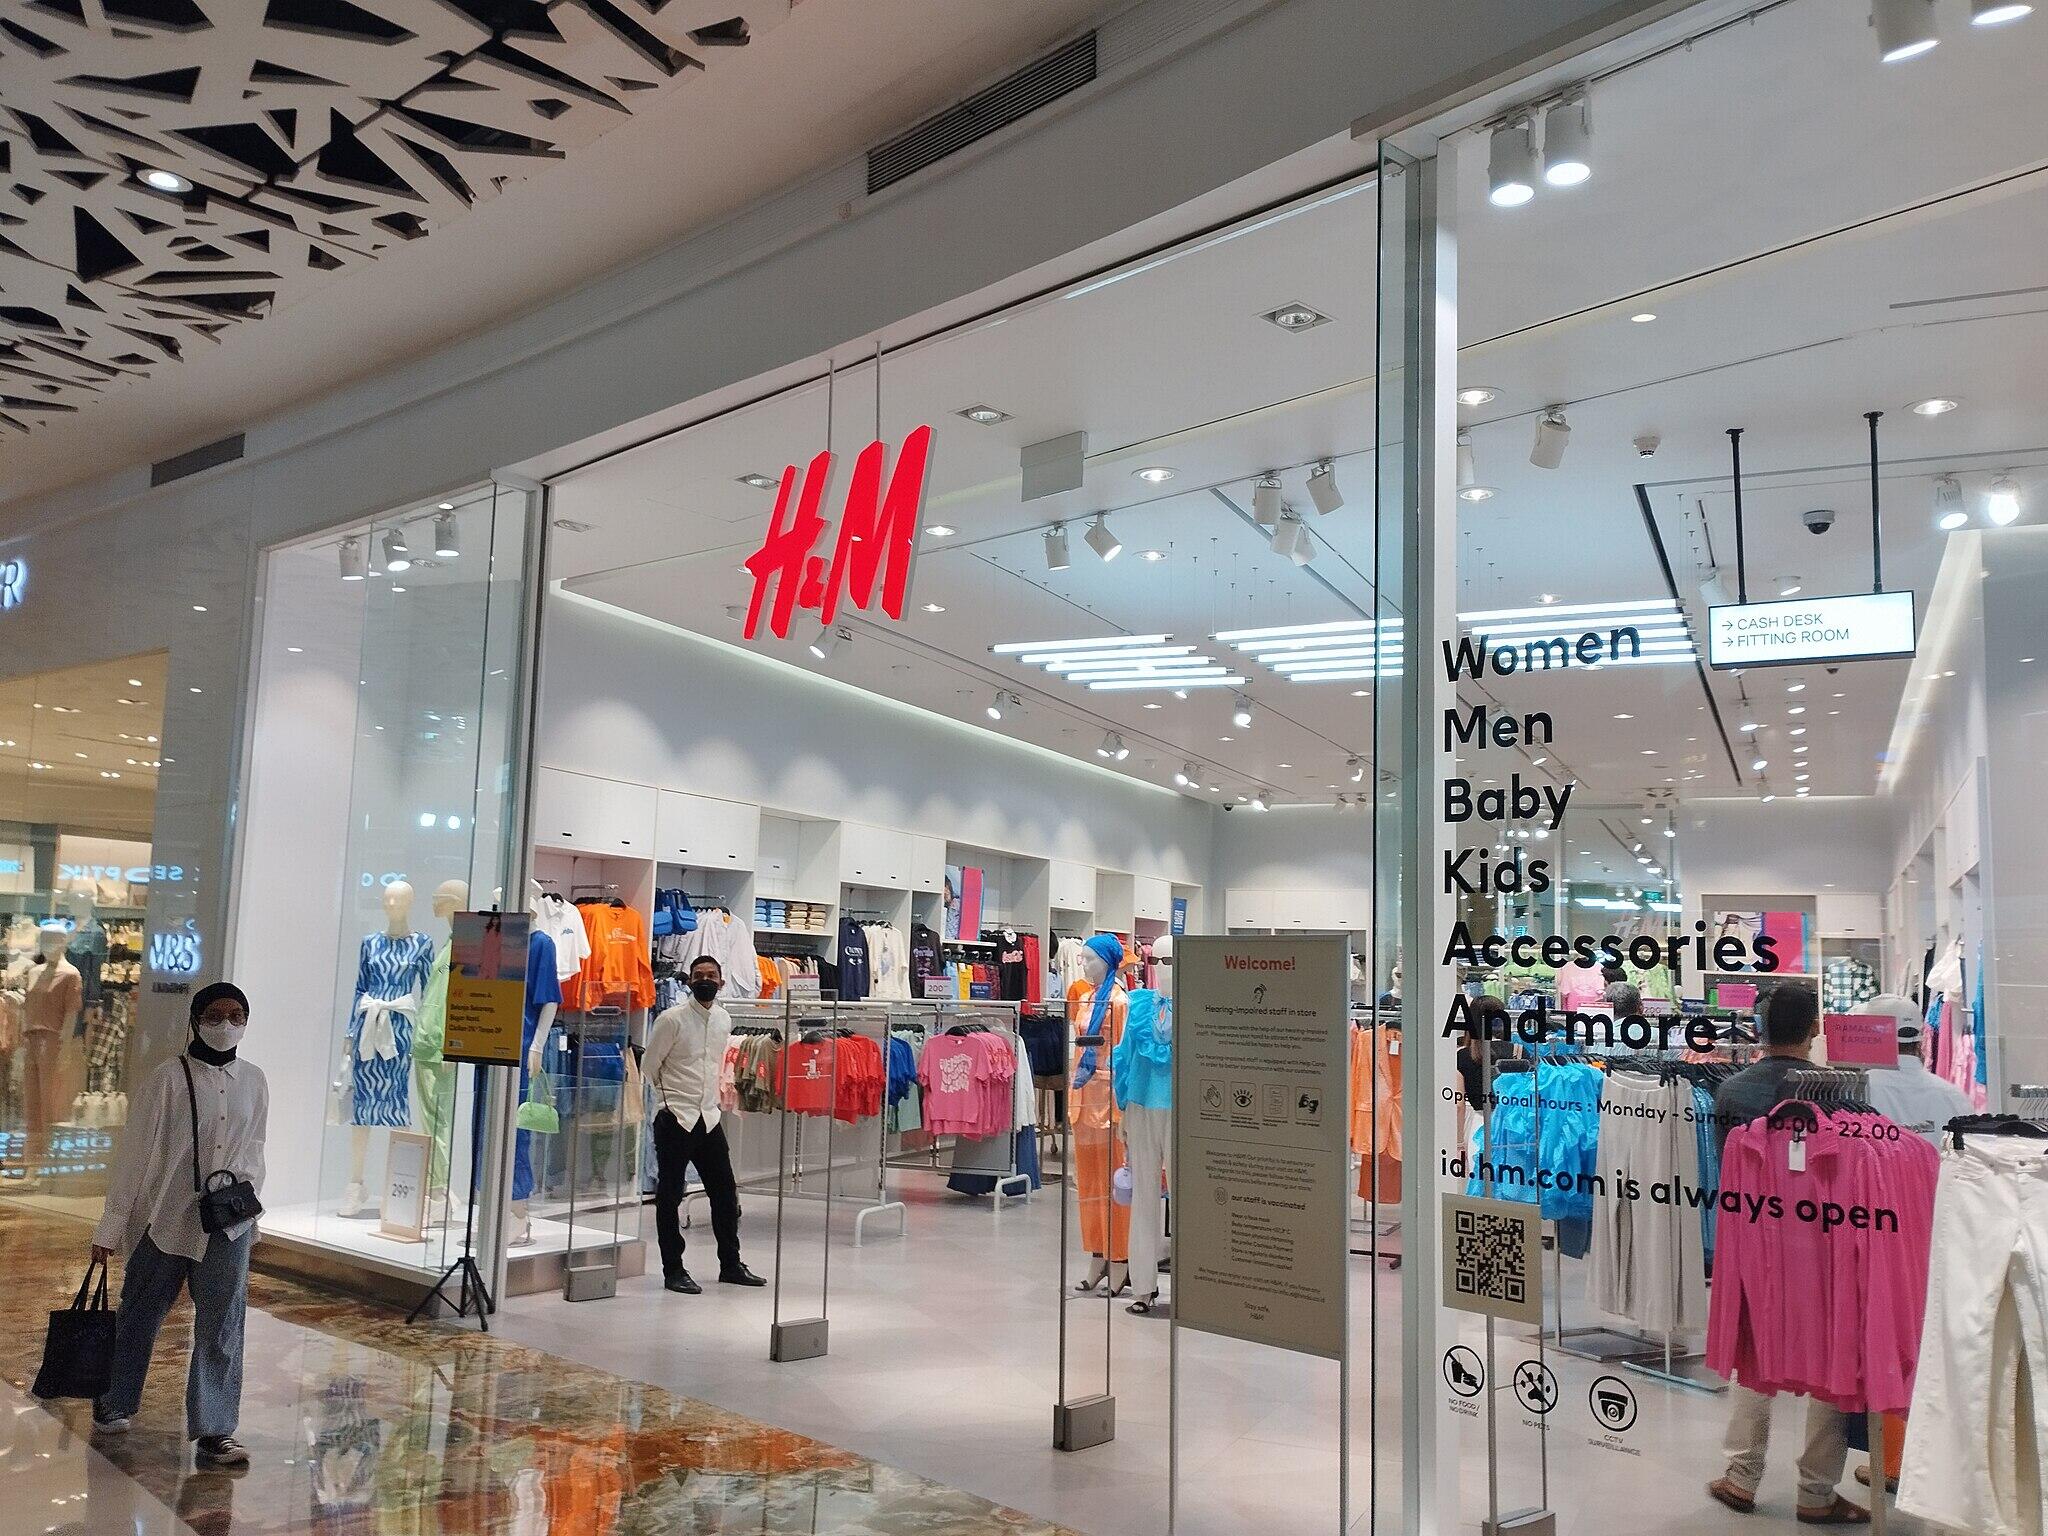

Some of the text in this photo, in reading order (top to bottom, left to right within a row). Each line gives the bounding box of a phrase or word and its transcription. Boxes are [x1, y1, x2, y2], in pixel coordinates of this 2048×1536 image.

[743, 424, 934, 640] H&M
[1737, 613, 1824, 631] CASH DESK
[1737, 628, 1850, 647] FITTING ROOM
[1441, 625, 1641, 683] Women
[1443, 704, 1554, 752] Men
[1443, 773, 1574, 830] Baby
[1443, 847, 1551, 895] Kids
[1224, 954, 1296, 971] Welcome!
[1441, 919, 1780, 973] Accessories
[1205, 1004, 1317, 1017] Hearing-impaired staff in store
[1441, 993, 1718, 1054] And more
[1834, 1022, 1887, 1033] RAMAD
[1441, 1086, 1533, 1107] Opeational
[1537, 1094, 1583, 1112] hours
[1596, 1099, 1668, 1123] Monday
[1838, 1120, 1900, 1142] 22.00
[1440, 1149, 1899, 1233] id.hm.com is always open
[1448, 1398, 1458, 1406] NO
[1459, 1400, 1477, 1410] FOOD
[1522, 1419, 1533, 1427] NO
